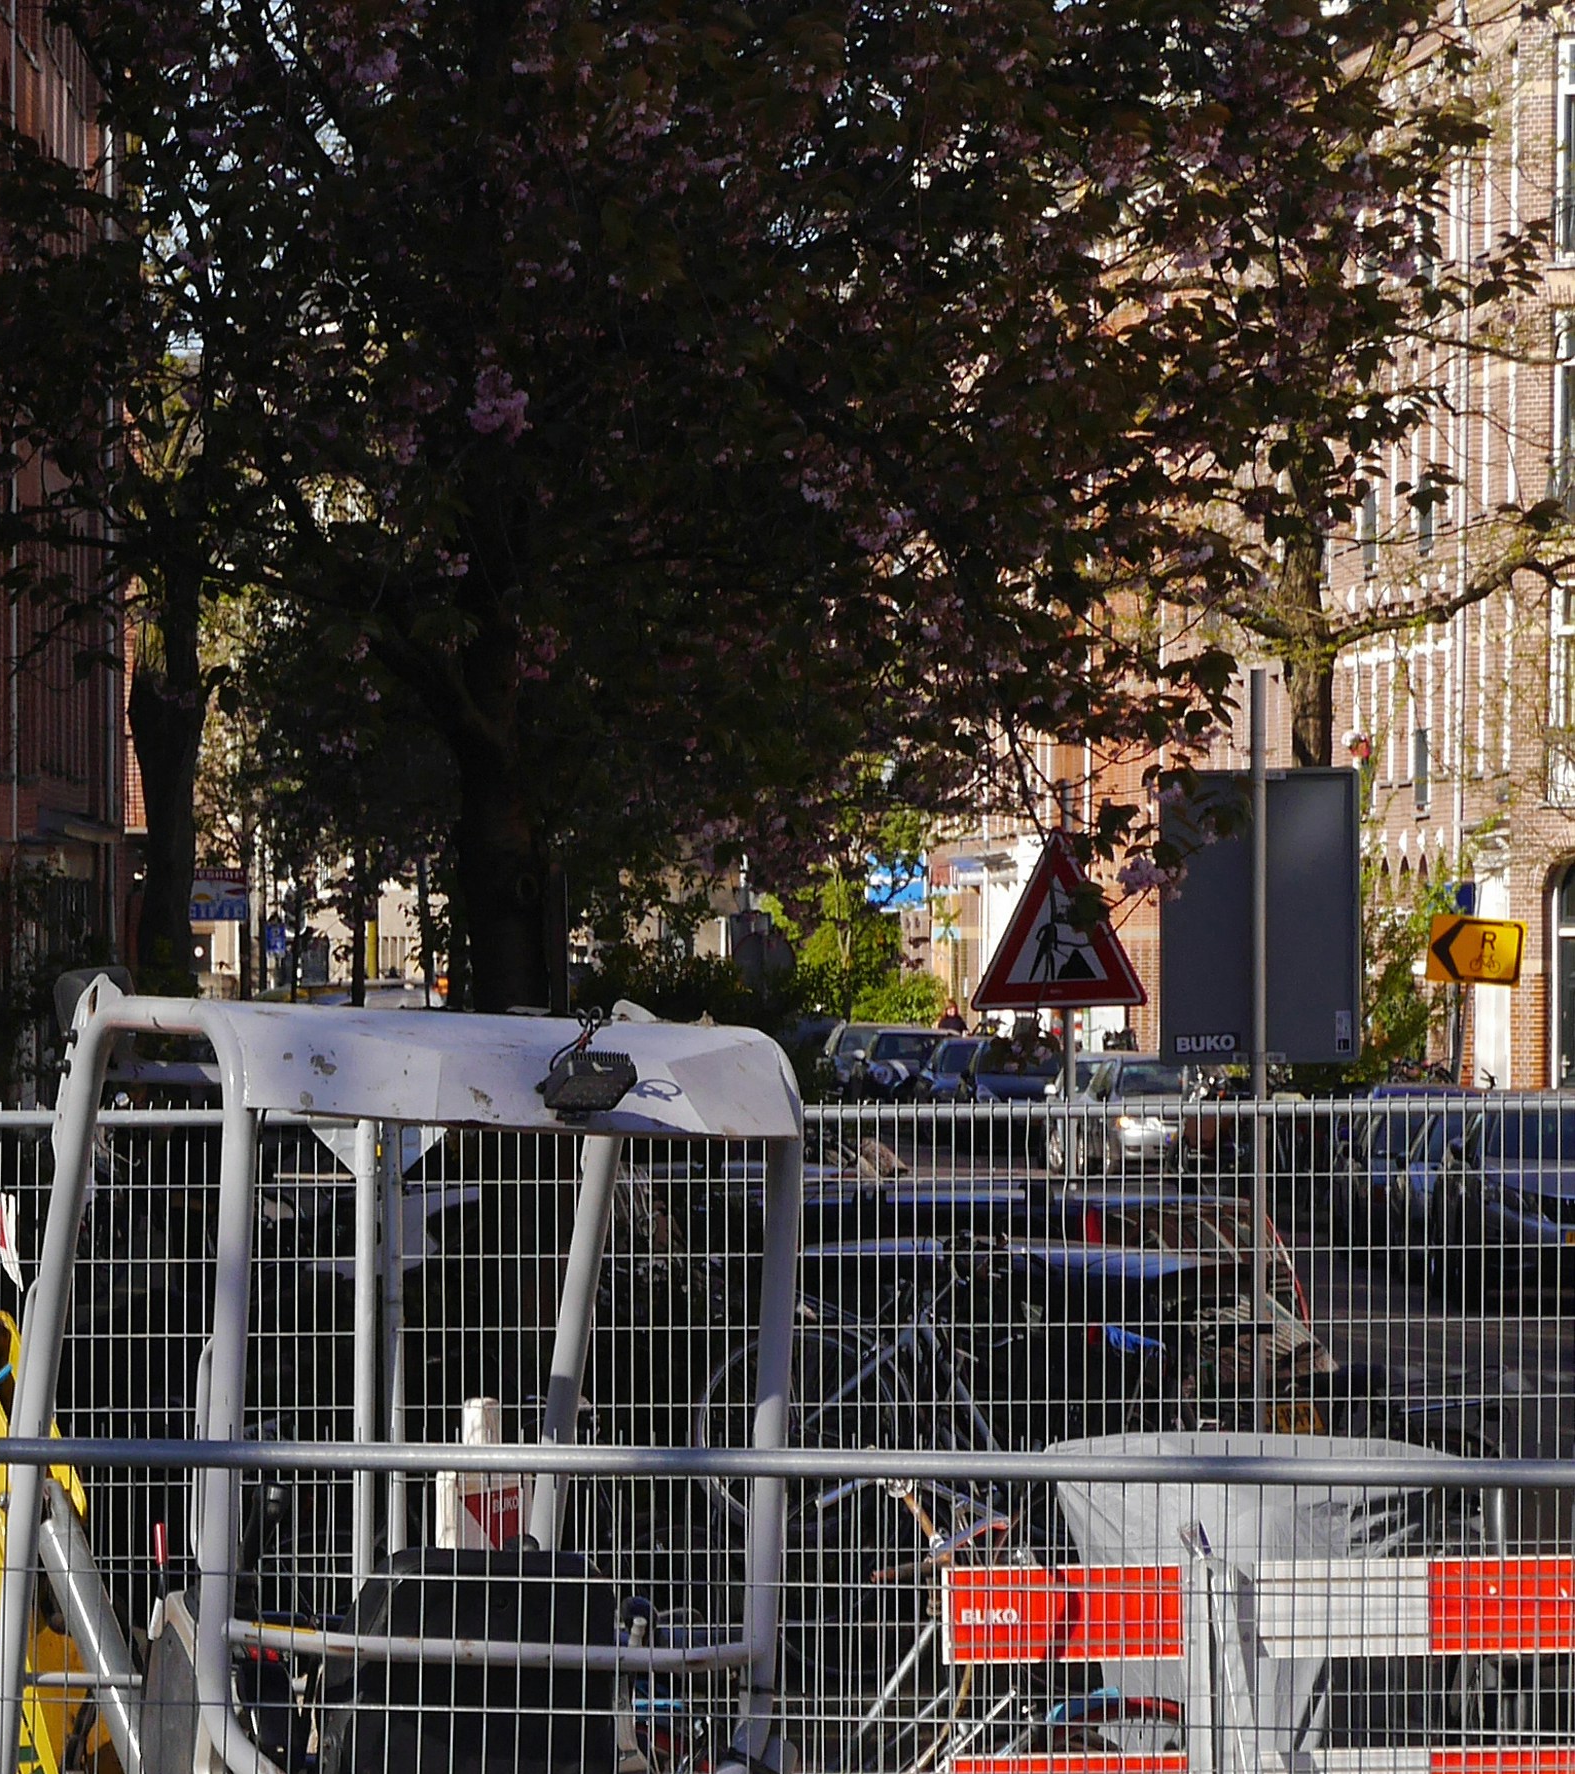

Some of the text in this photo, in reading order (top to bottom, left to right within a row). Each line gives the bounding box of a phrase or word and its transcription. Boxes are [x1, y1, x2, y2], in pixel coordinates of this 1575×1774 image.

[1481, 931, 1497, 950] R
[1175, 1034, 1236, 1053] BUKO
[491, 1495, 519, 1514] BUKO
[961, 1607, 1018, 1625] BUKO
